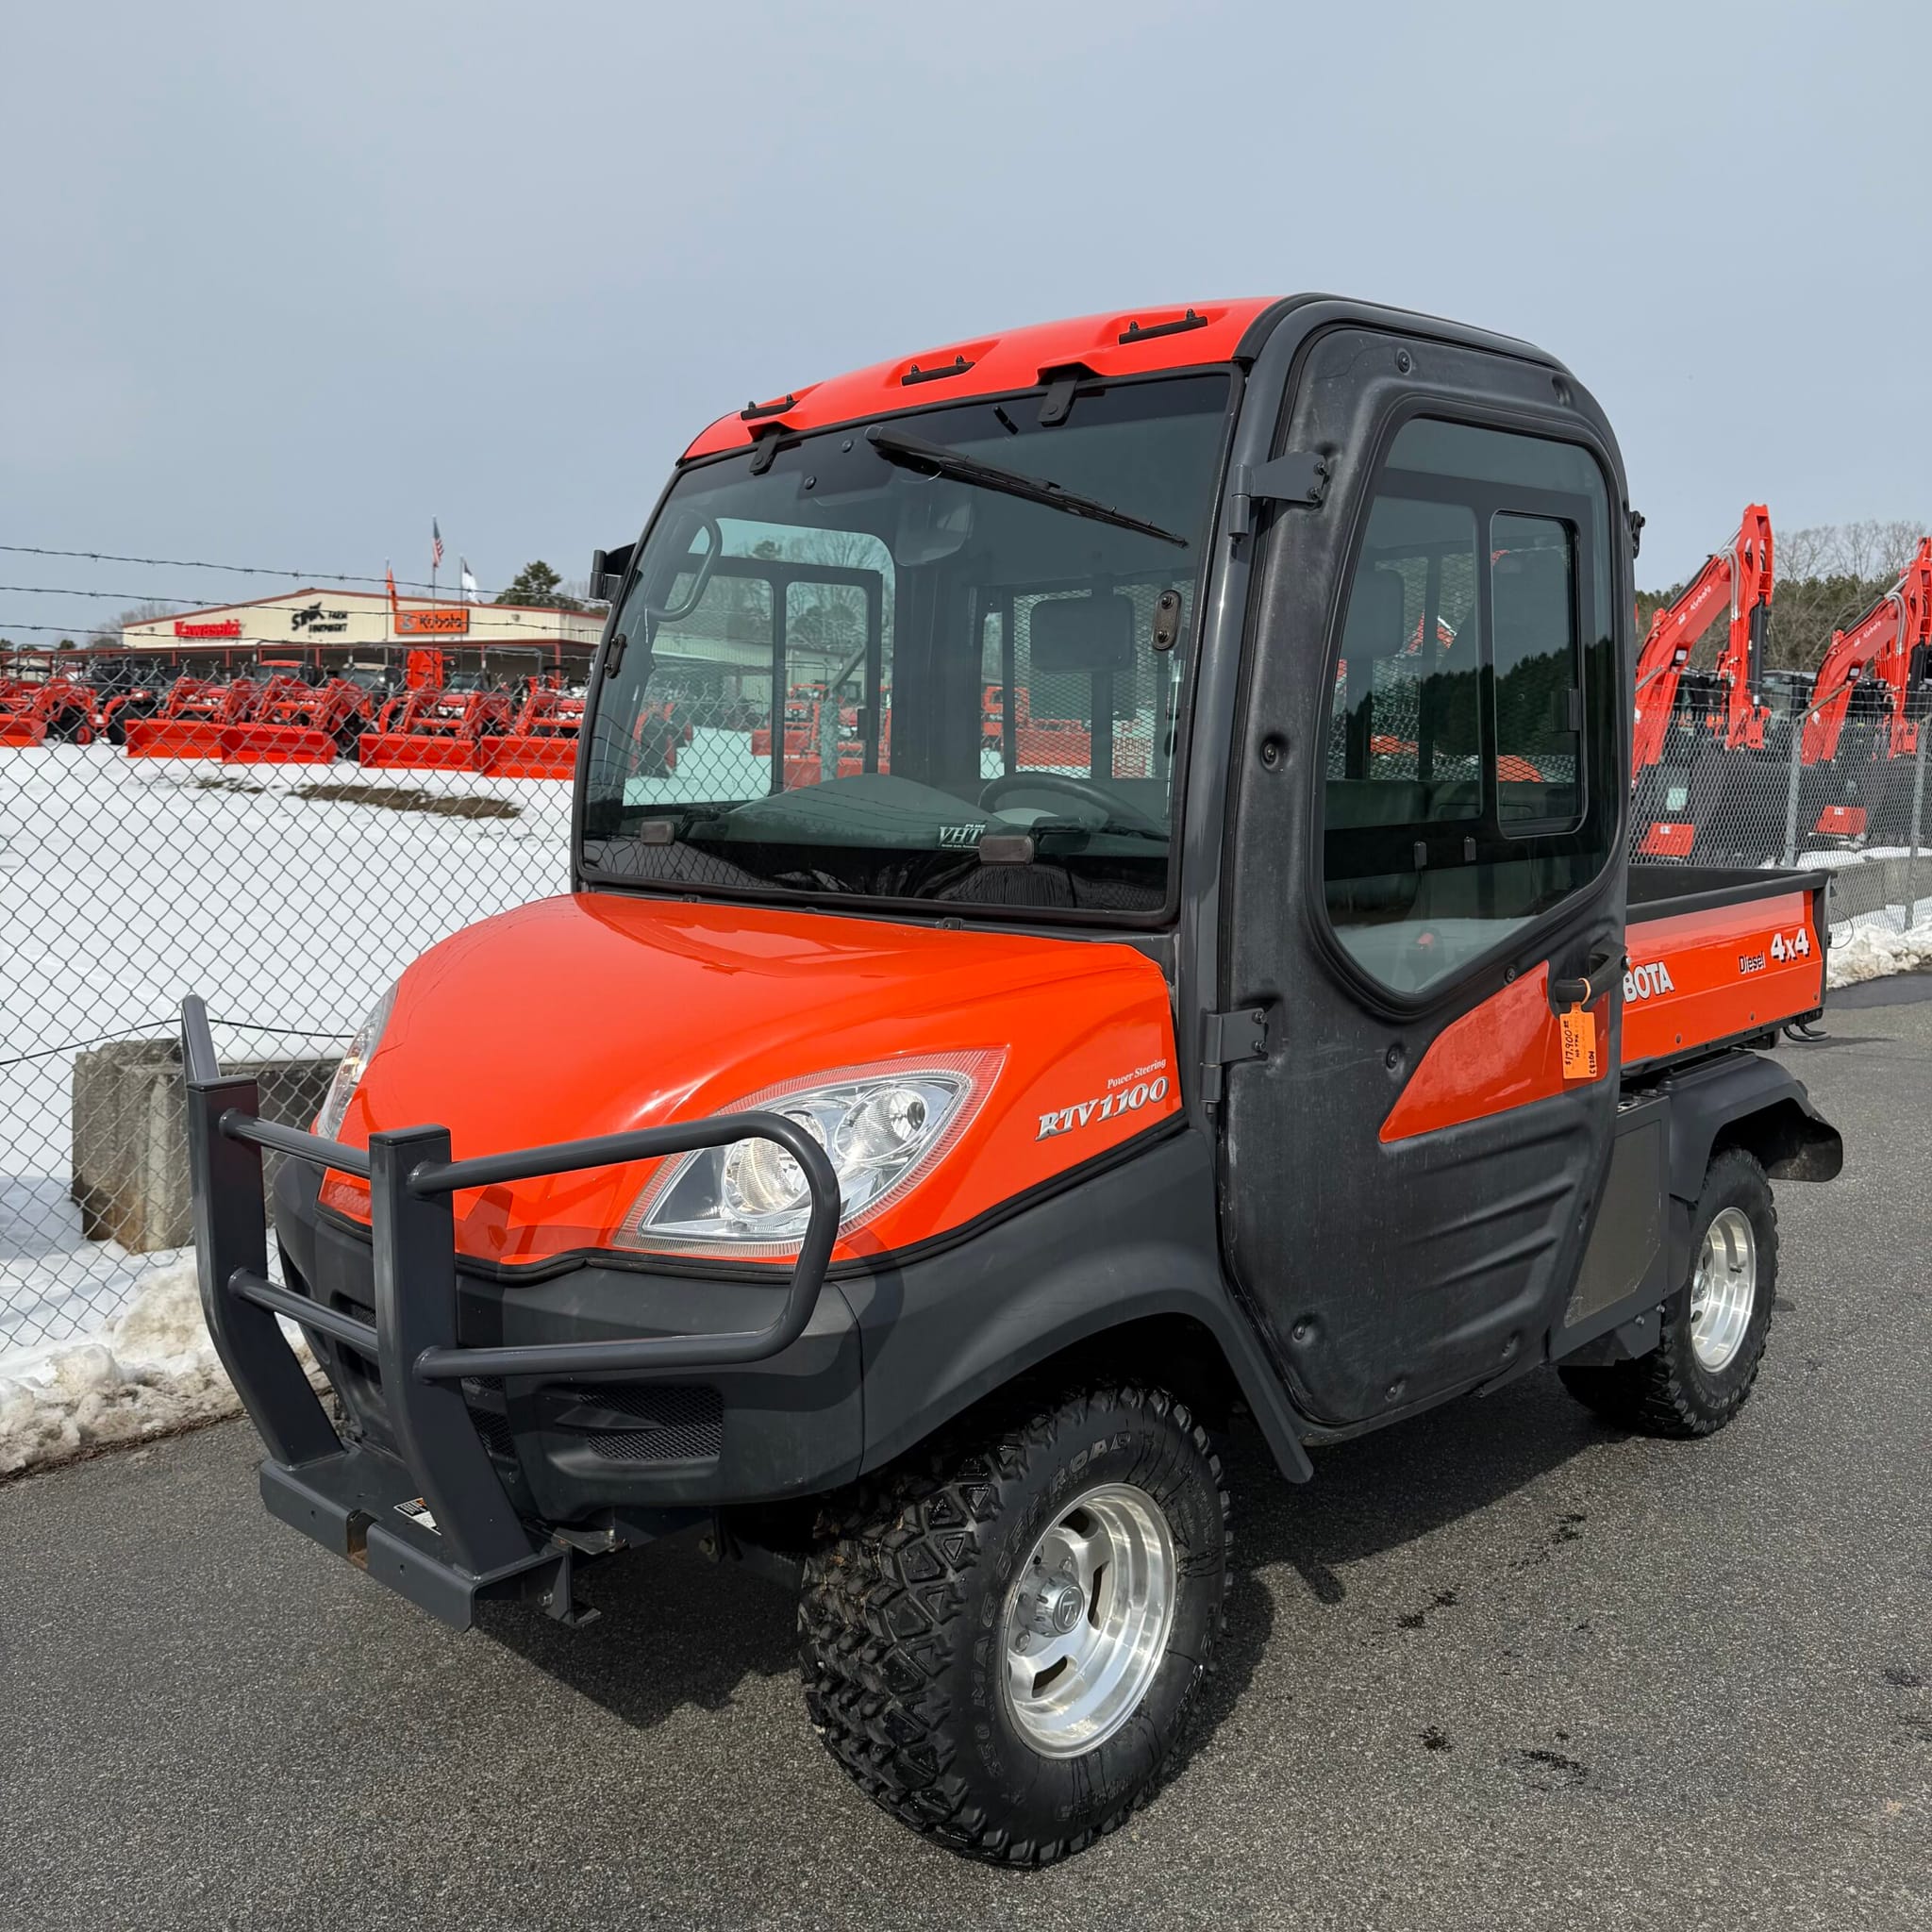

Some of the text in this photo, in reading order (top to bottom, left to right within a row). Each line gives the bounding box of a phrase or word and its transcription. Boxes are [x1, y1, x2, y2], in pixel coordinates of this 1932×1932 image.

[175, 619, 242, 638] Kawasaki
[939, 826, 984, 845] VHT
[1739, 927, 1810, 974] Diesel 4x4
[1107, 1058, 1167, 1090] Power Steering
[1035, 1075, 1169, 1141] RTV1100
[1050, 1431, 1133, 1494] ROAD
